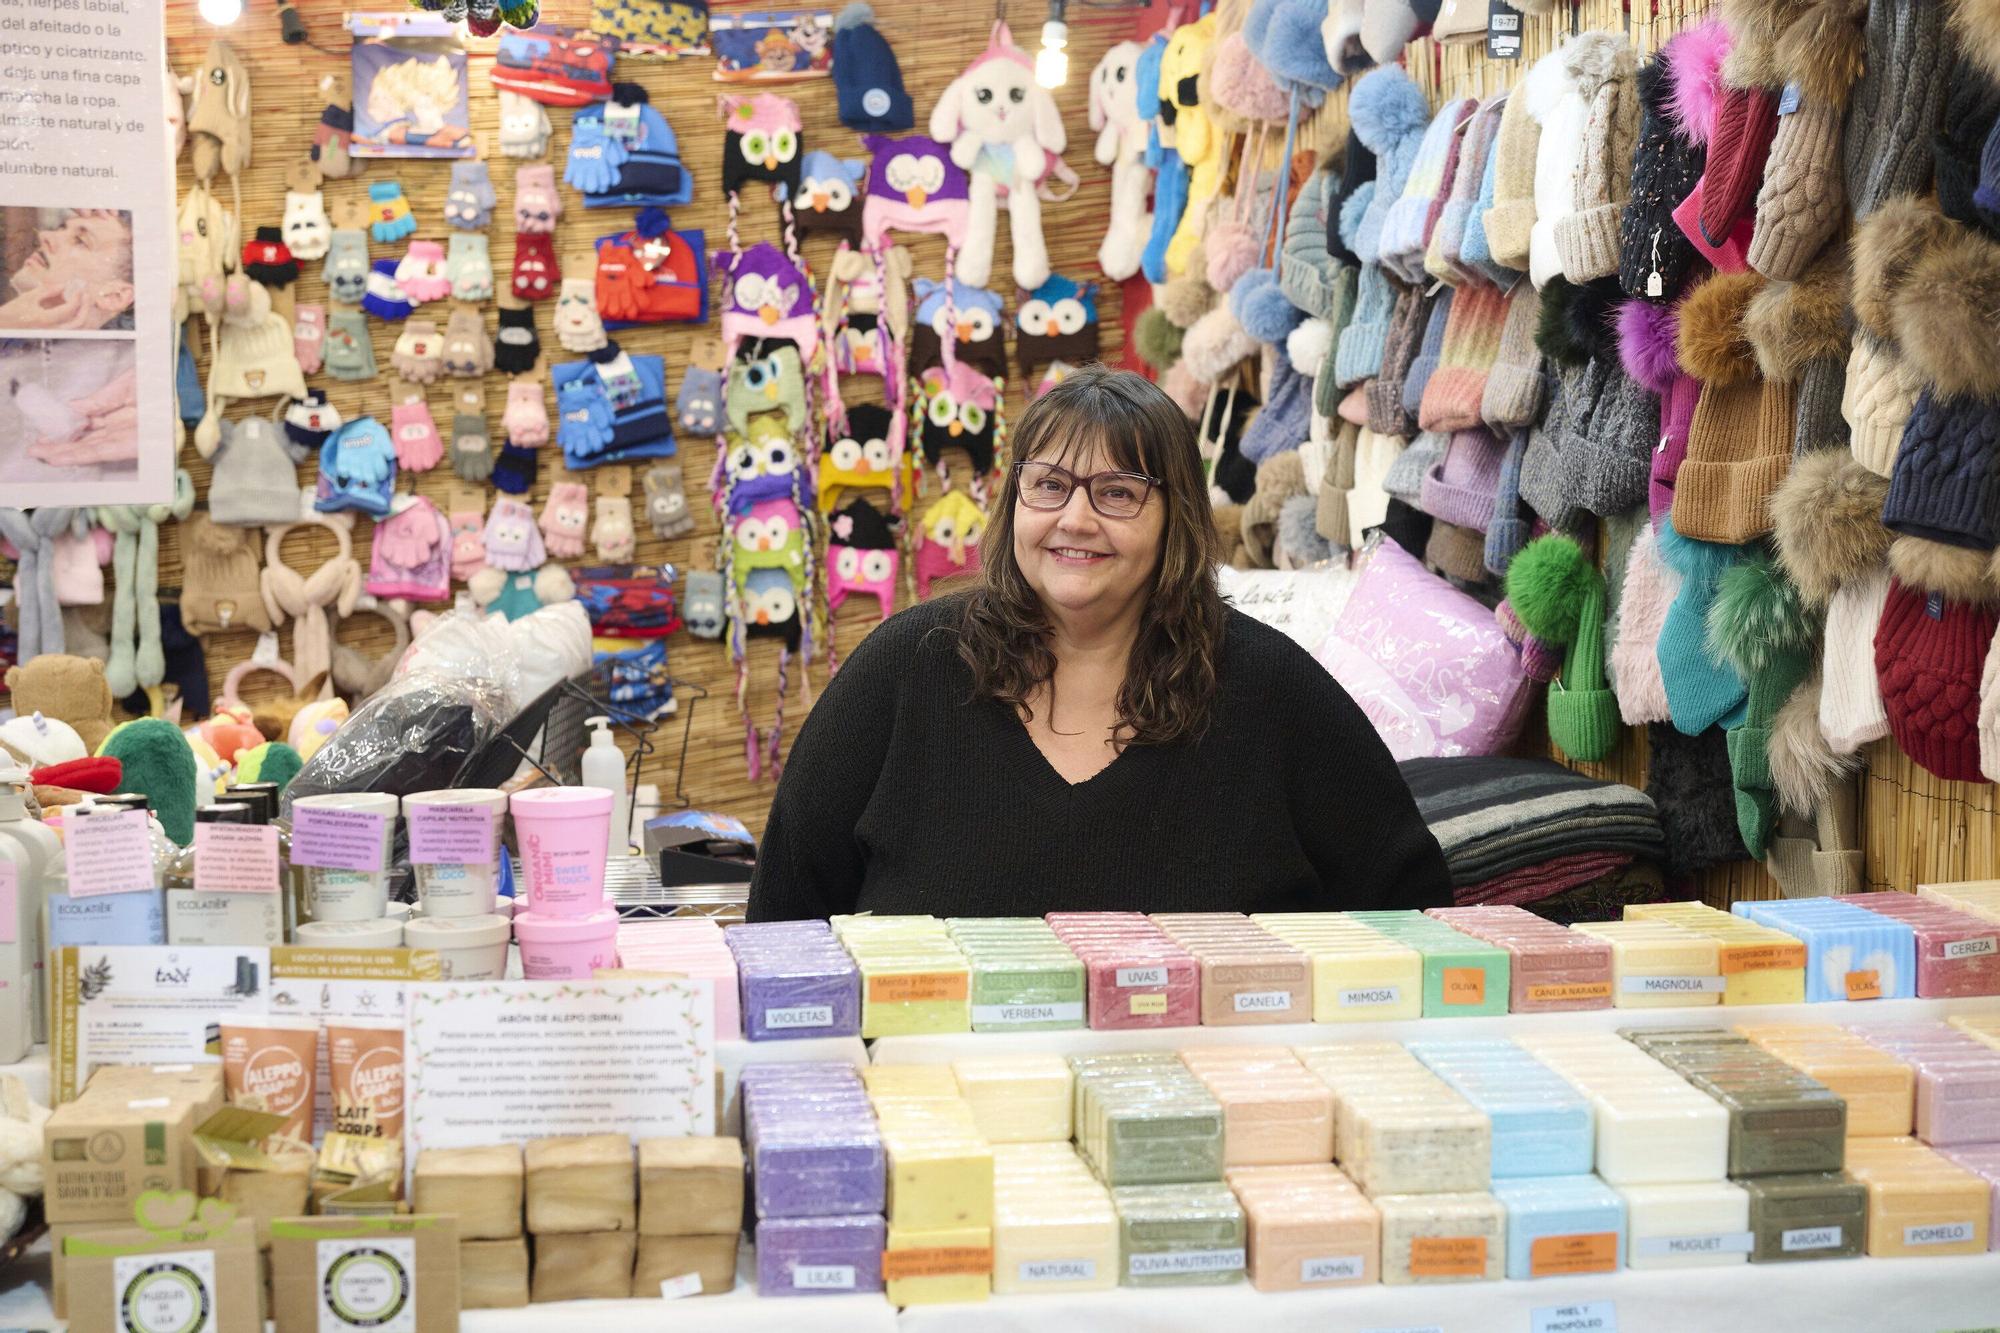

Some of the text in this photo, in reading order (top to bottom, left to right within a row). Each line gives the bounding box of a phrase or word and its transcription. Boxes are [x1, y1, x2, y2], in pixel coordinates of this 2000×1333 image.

[84, 0, 129, 14] labial,
[2, 18, 121, 37] del afeitado o la
[0, 44, 147, 62] ptico y cicatrizante.
[41, 70, 69, 82] una
[73, 69, 100, 83] fina
[104, 72, 141, 87] capa
[65, 92, 79, 106] la
[83, 95, 121, 108] ropa.
[0, 114, 144, 134] lmente natural y de
[61, 164, 119, 178] natural.
[1951, 941, 1991, 955] CEREZA
[920, 975, 959, 985] Romero
[1128, 970, 1158, 983] UVAS
[1451, 982, 1478, 991] OLIVA
[1646, 979, 1703, 990] MAGNOLIA
[1850, 983, 1876, 992] LILAS
[1348, 991, 1393, 1003] MIMOSA
[1534, 986, 1607, 998] CANELA NARANJA
[1240, 996, 1285, 1008] CANELA
[534, 1014, 548, 1022] DE
[771, 1011, 827, 1024] VIOLETAS
[1001, 1007, 1054, 1019] VERBENA
[248, 1060, 303, 1084] ALEPPO
[336, 1106, 369, 1119] LAIT
[336, 1121, 383, 1138] CORPS
[1790, 1232, 1832, 1246] ARGAN
[1912, 1226, 1964, 1241] POMELO
[1669, 1238, 1721, 1251] MUGUET
[1133, 1253, 1242, 1271] OLIVA-NUTRITIVO
[1029, 1265, 1087, 1277] NATURAL
[1311, 1262, 1354, 1277] JAZMÍN
[808, 1271, 843, 1284] LILAS
[1556, 1307, 1580, 1317] MIEL
[1546, 1318, 1602, 1331] PROPÓLEO
